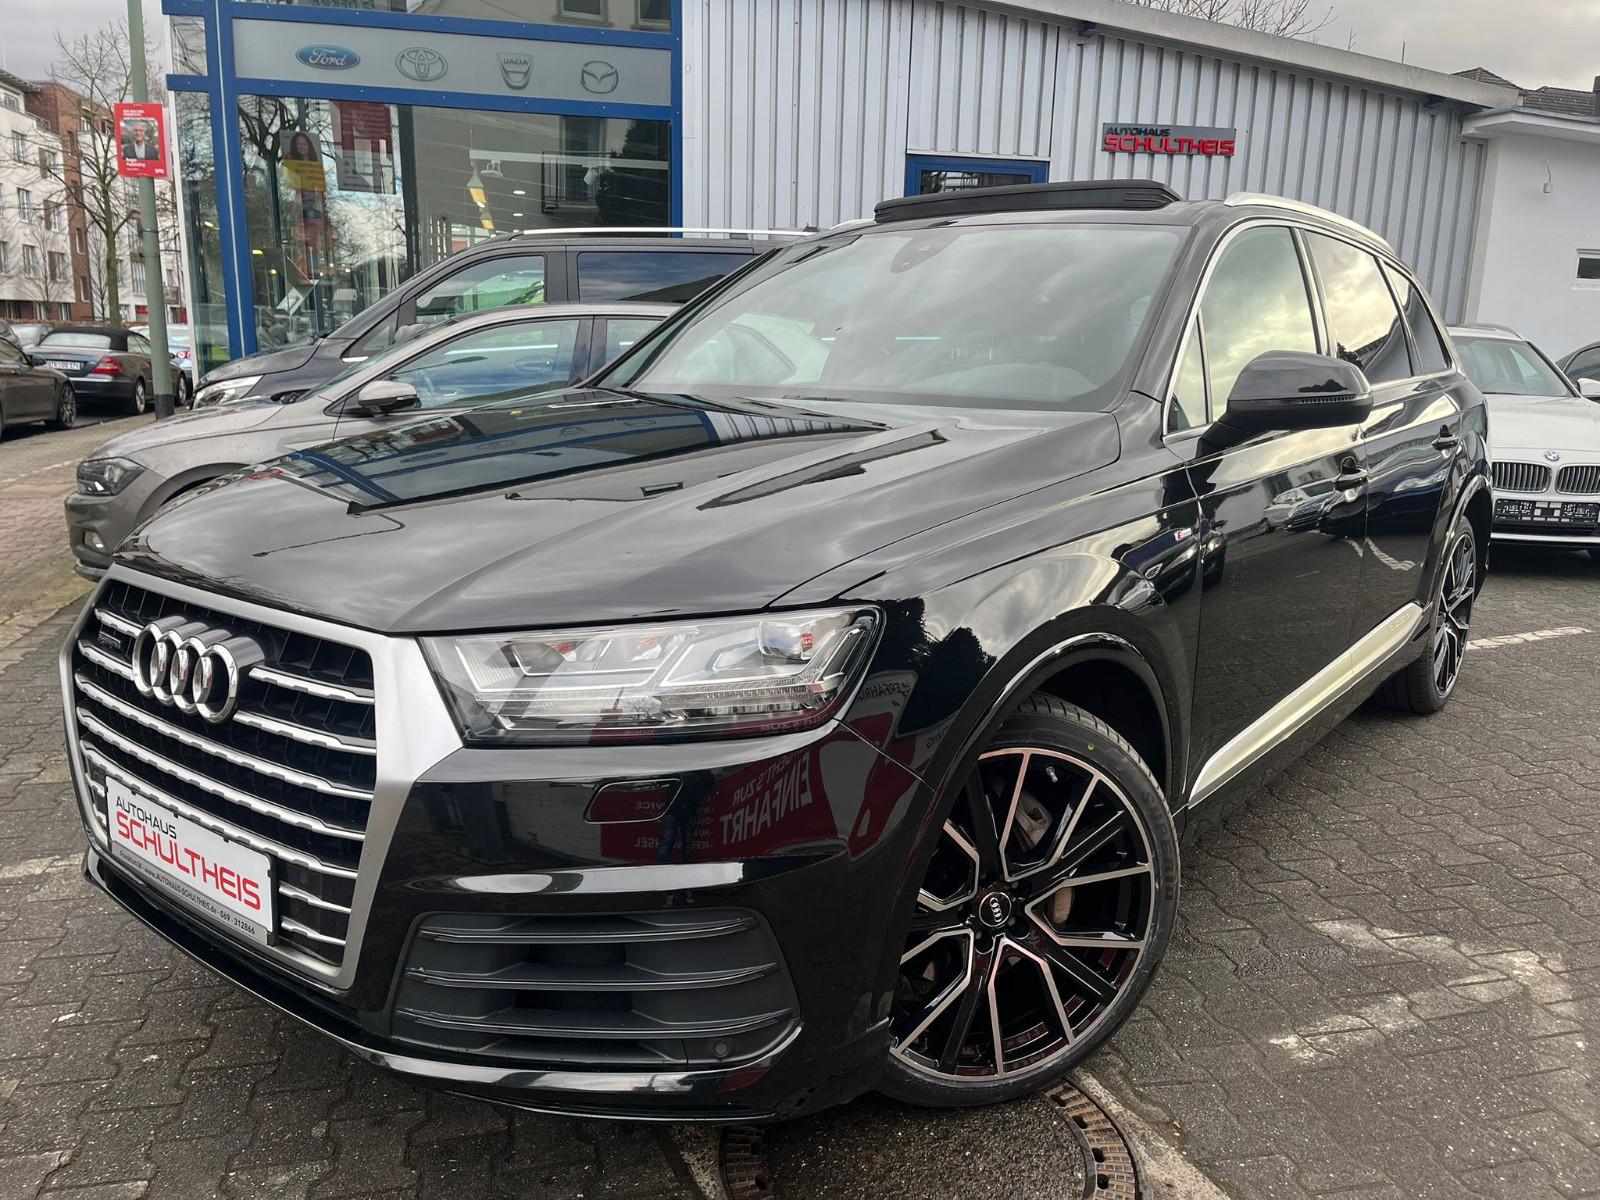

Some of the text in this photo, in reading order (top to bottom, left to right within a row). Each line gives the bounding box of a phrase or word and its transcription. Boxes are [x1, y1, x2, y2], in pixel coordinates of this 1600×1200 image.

[309, 47, 348, 66] Ford
[503, 57, 529, 66] DACIA
[1105, 126, 1171, 138] AUTOHAUS
[1103, 135, 1236, 156] SCHULTHEIS
[116, 796, 177, 840] AUTOHAUS
[116, 810, 261, 912] SCHULTHEIS
